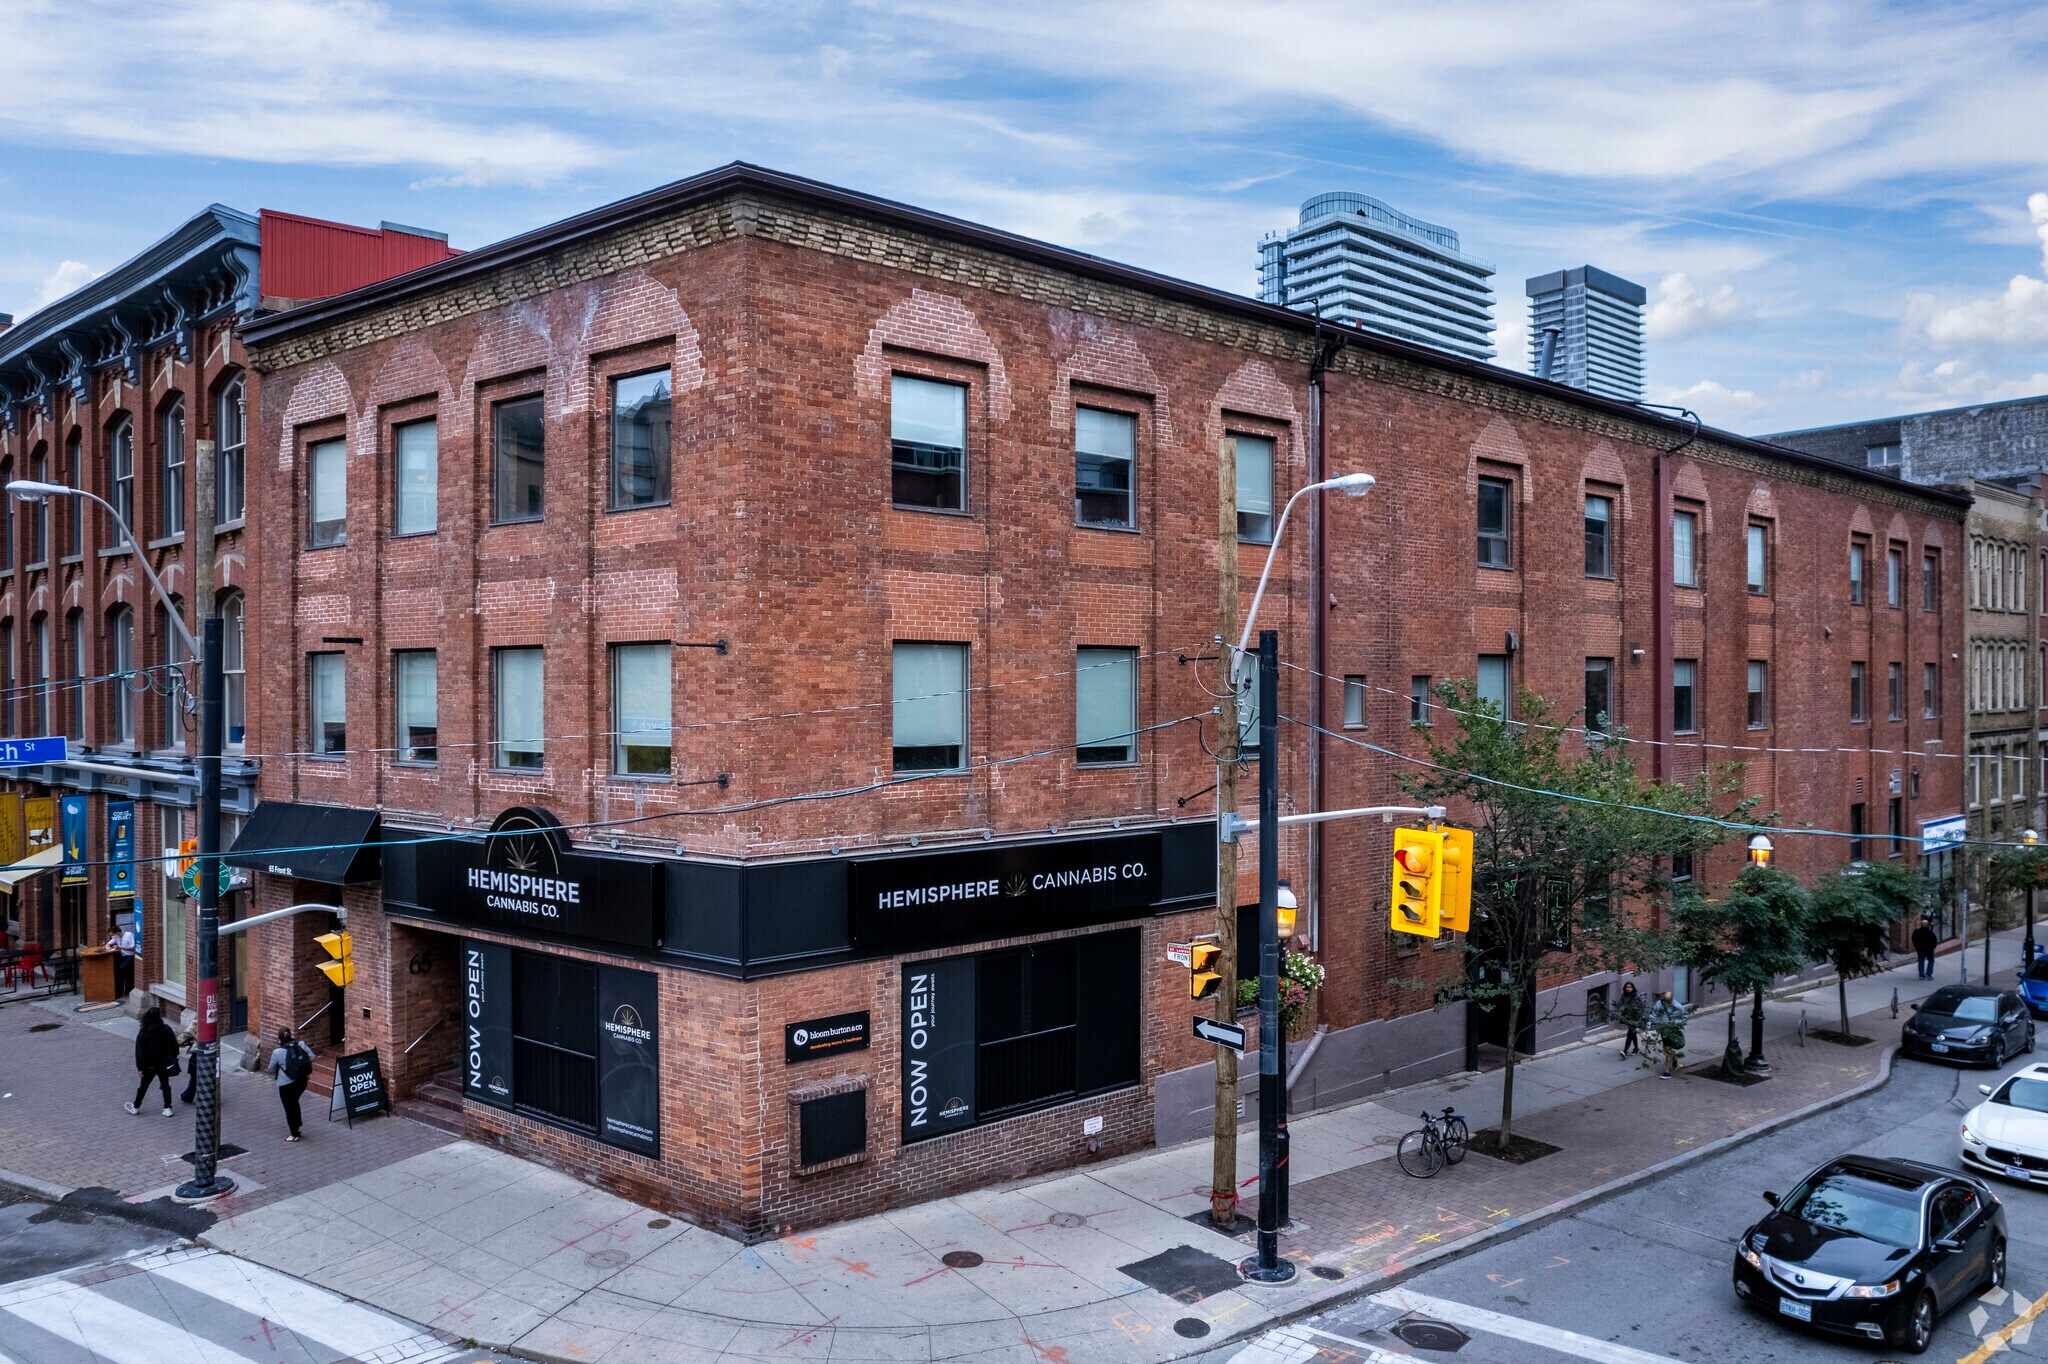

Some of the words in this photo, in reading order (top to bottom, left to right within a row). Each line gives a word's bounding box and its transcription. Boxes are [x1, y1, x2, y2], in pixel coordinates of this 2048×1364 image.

[24, 742, 36, 751] St
[184, 864, 199, 879] DON
[268, 864, 275, 873] 65
[275, 865, 286, 874] Front
[468, 867, 580, 904] HEMISPHERE
[878, 879, 999, 910] HEMISPHERE
[1032, 866, 1117, 890] CANNABIS
[1122, 862, 1147, 879] CO.
[486, 894, 539, 915] CANNABIS
[541, 904, 560, 918] CO.
[408, 953, 431, 975] 65
[1174, 953, 1190, 961] FRON
[468, 950, 481, 1019] OPEN
[910, 974, 928, 1050] OPEN
[605, 1021, 651, 1040] HEMISPHERE
[612, 1032, 635, 1043] CANNABIS
[810, 1029, 830, 1040] bloom
[470, 1024, 482, 1089] NOW
[349, 1071, 374, 1085] NOW
[350, 1079, 377, 1093] OPEN
[910, 1059, 928, 1127] NOW
[939, 1104, 969, 1117] HEMISPHERE
